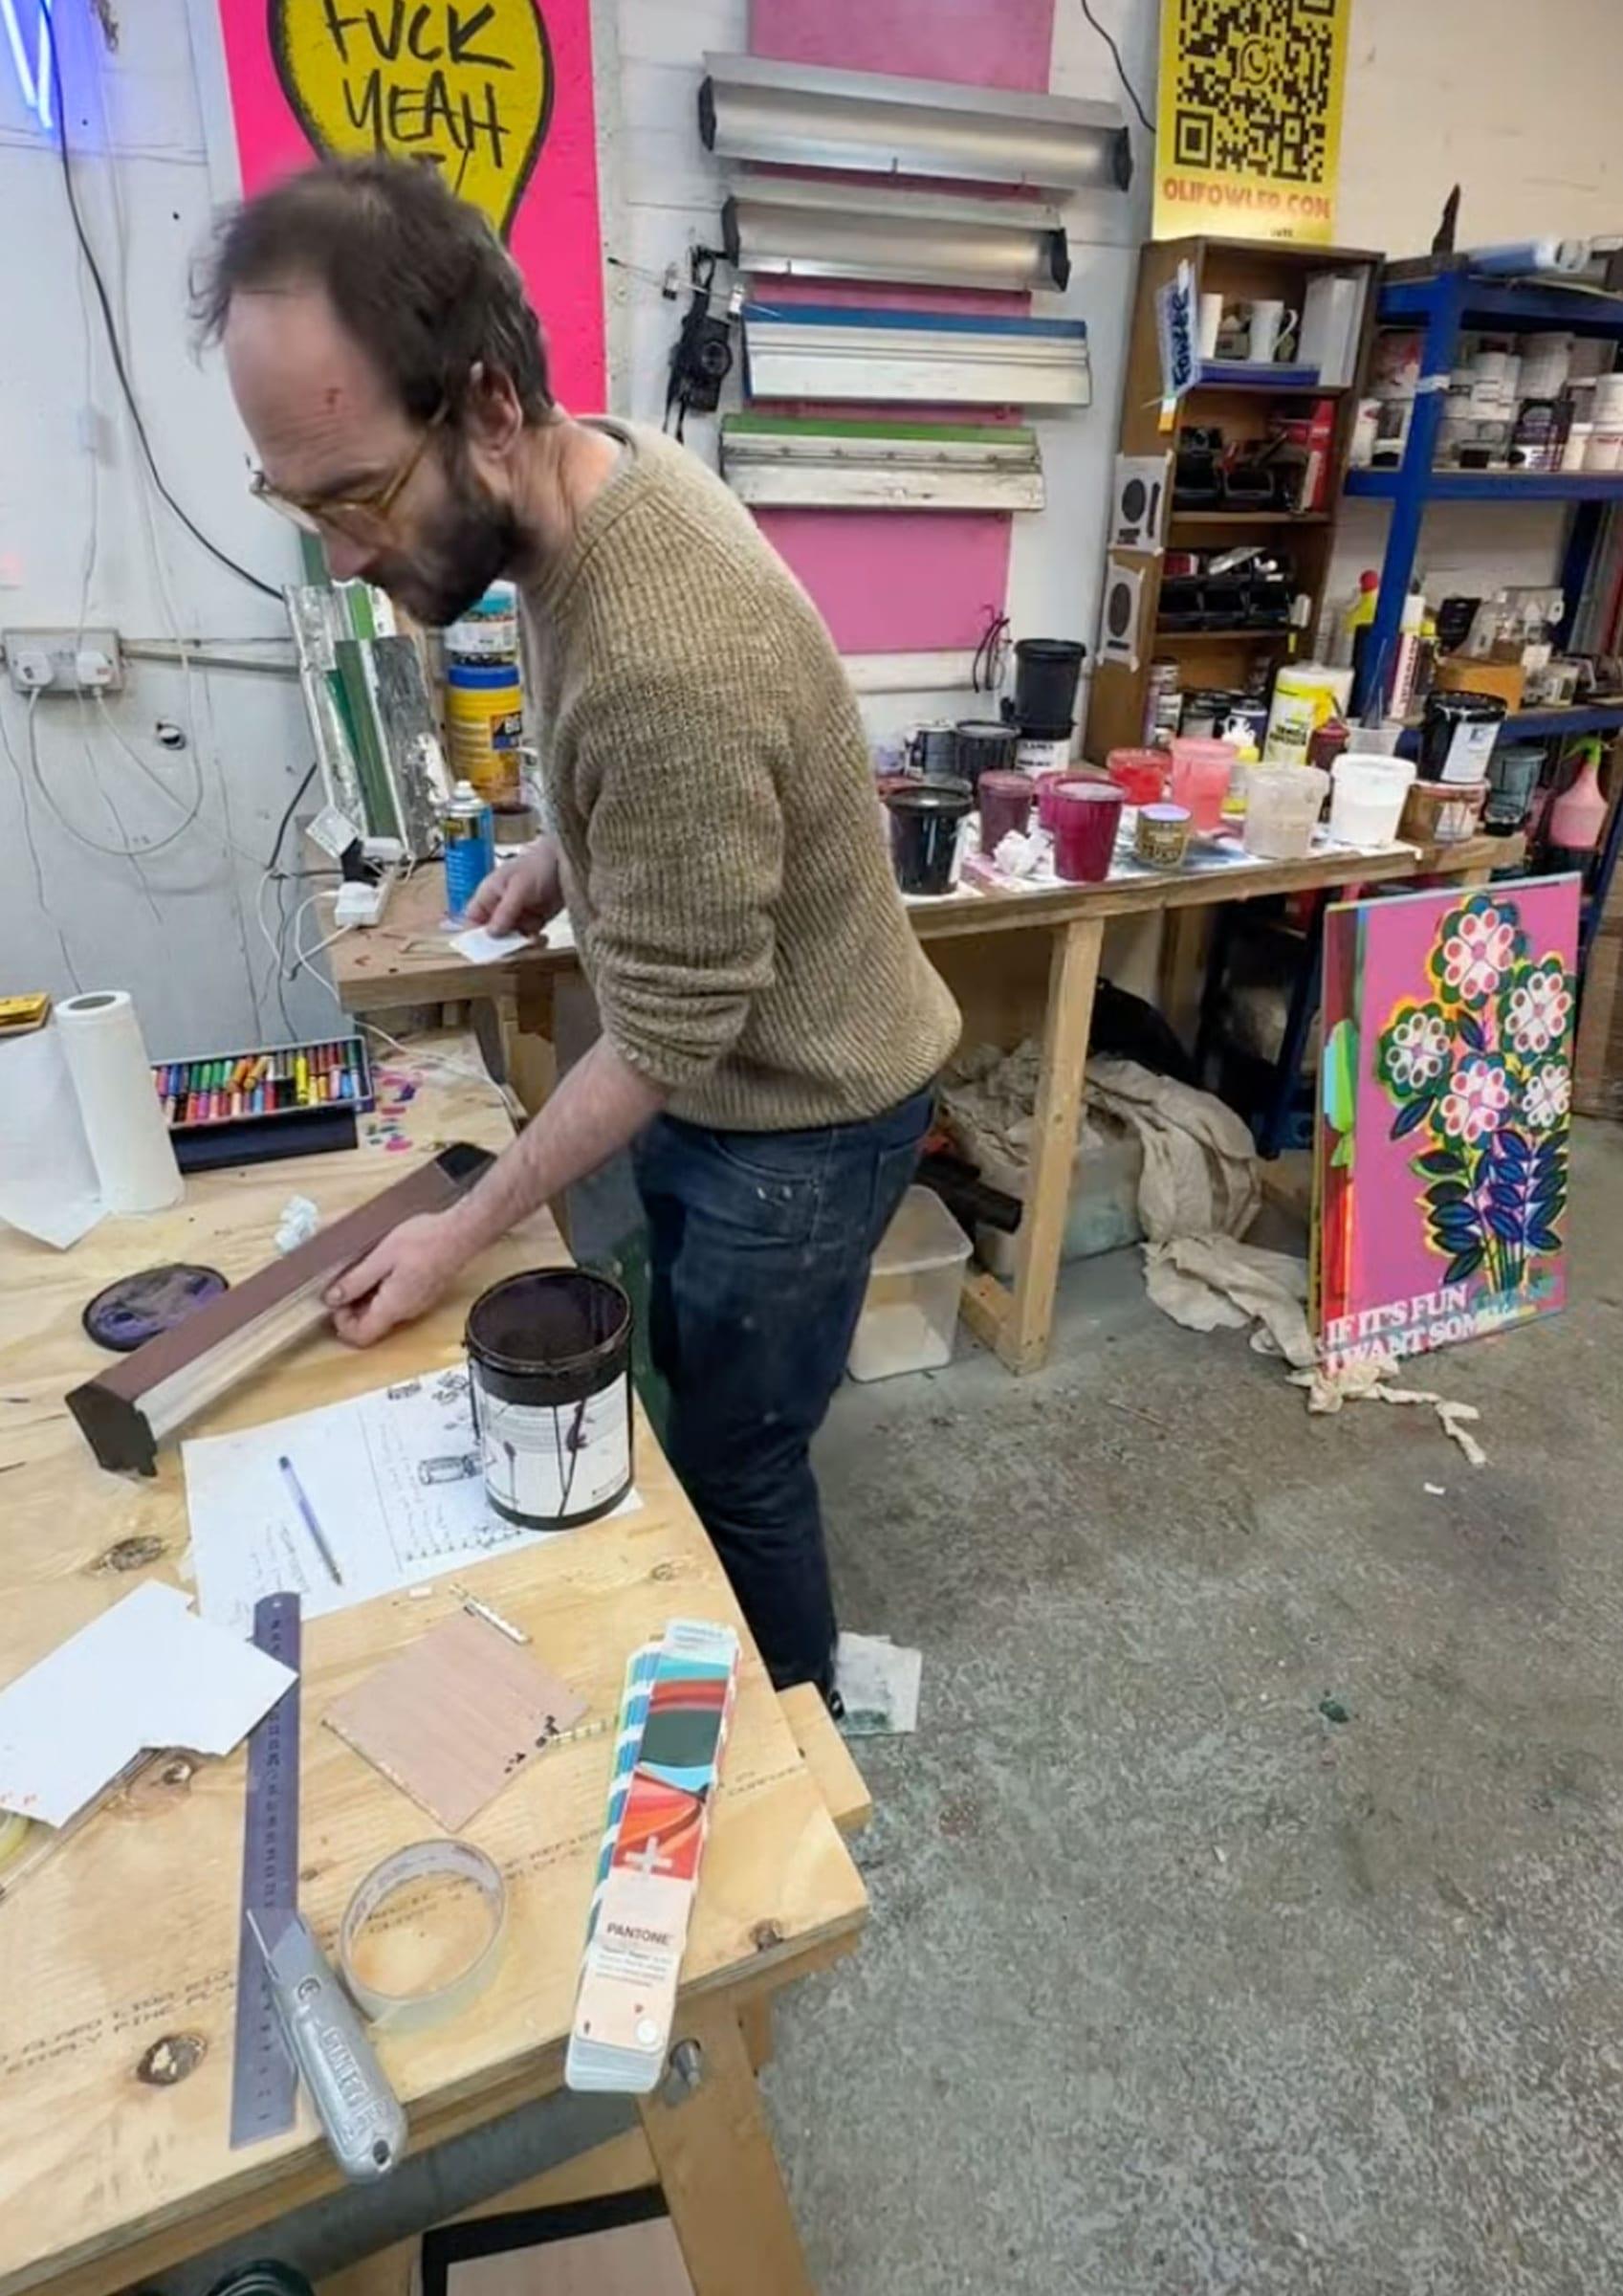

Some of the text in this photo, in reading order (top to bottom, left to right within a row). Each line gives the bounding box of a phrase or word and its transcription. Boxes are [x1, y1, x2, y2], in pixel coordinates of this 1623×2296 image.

[323, 0, 515, 70] FUCK
[341, 68, 512, 169] YEAH
[1327, 1314, 1356, 1346] IF
[1410, 1282, 1468, 1322] FUN
[606, 1921, 670, 1946] PANTONE
